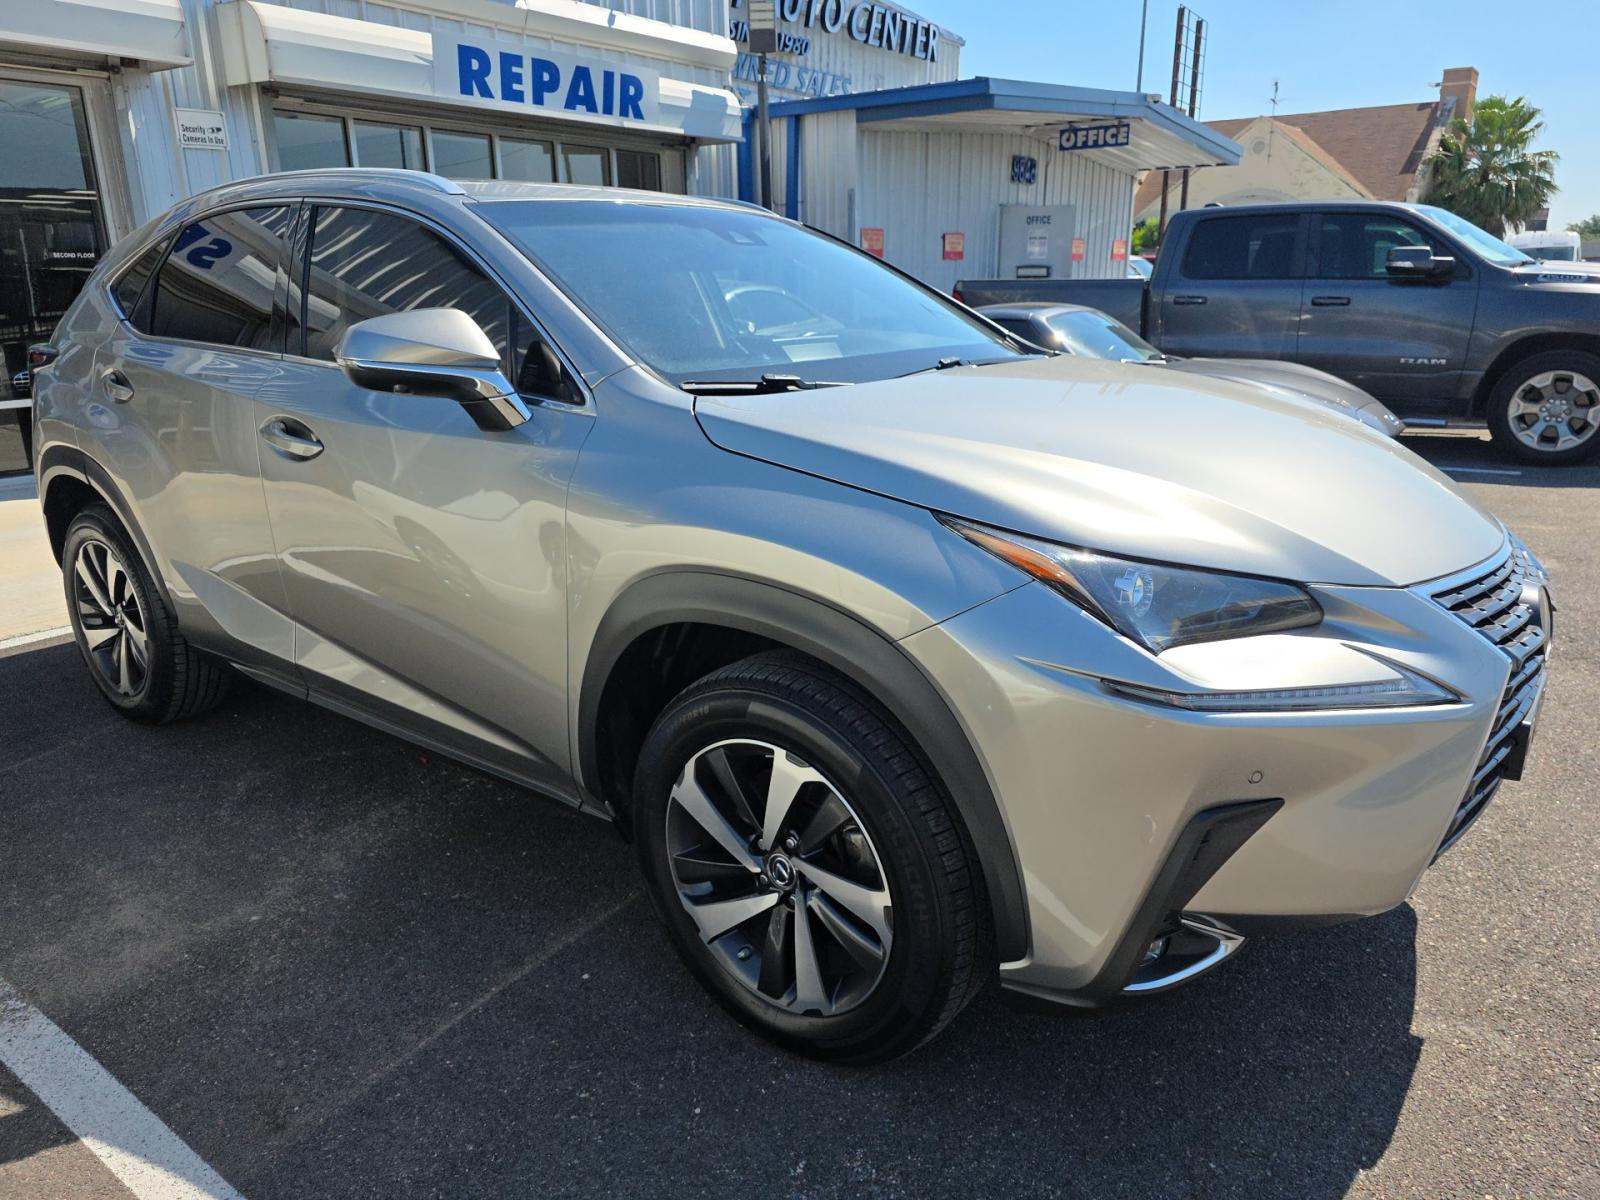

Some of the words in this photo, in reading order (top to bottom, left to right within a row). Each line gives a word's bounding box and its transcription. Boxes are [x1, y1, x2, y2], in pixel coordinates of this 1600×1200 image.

[849, 2, 939, 62] CENTER
[777, 32, 810, 56] 1980
[457, 44, 645, 120] REPAIR
[795, 66, 852, 96] SALES
[181, 123, 206, 135] Security
[182, 133, 207, 144] Cameras
[1060, 127, 1128, 149] OFFICE
[1026, 215, 1052, 225] OFFICE
[1400, 357, 1447, 365] RAM
